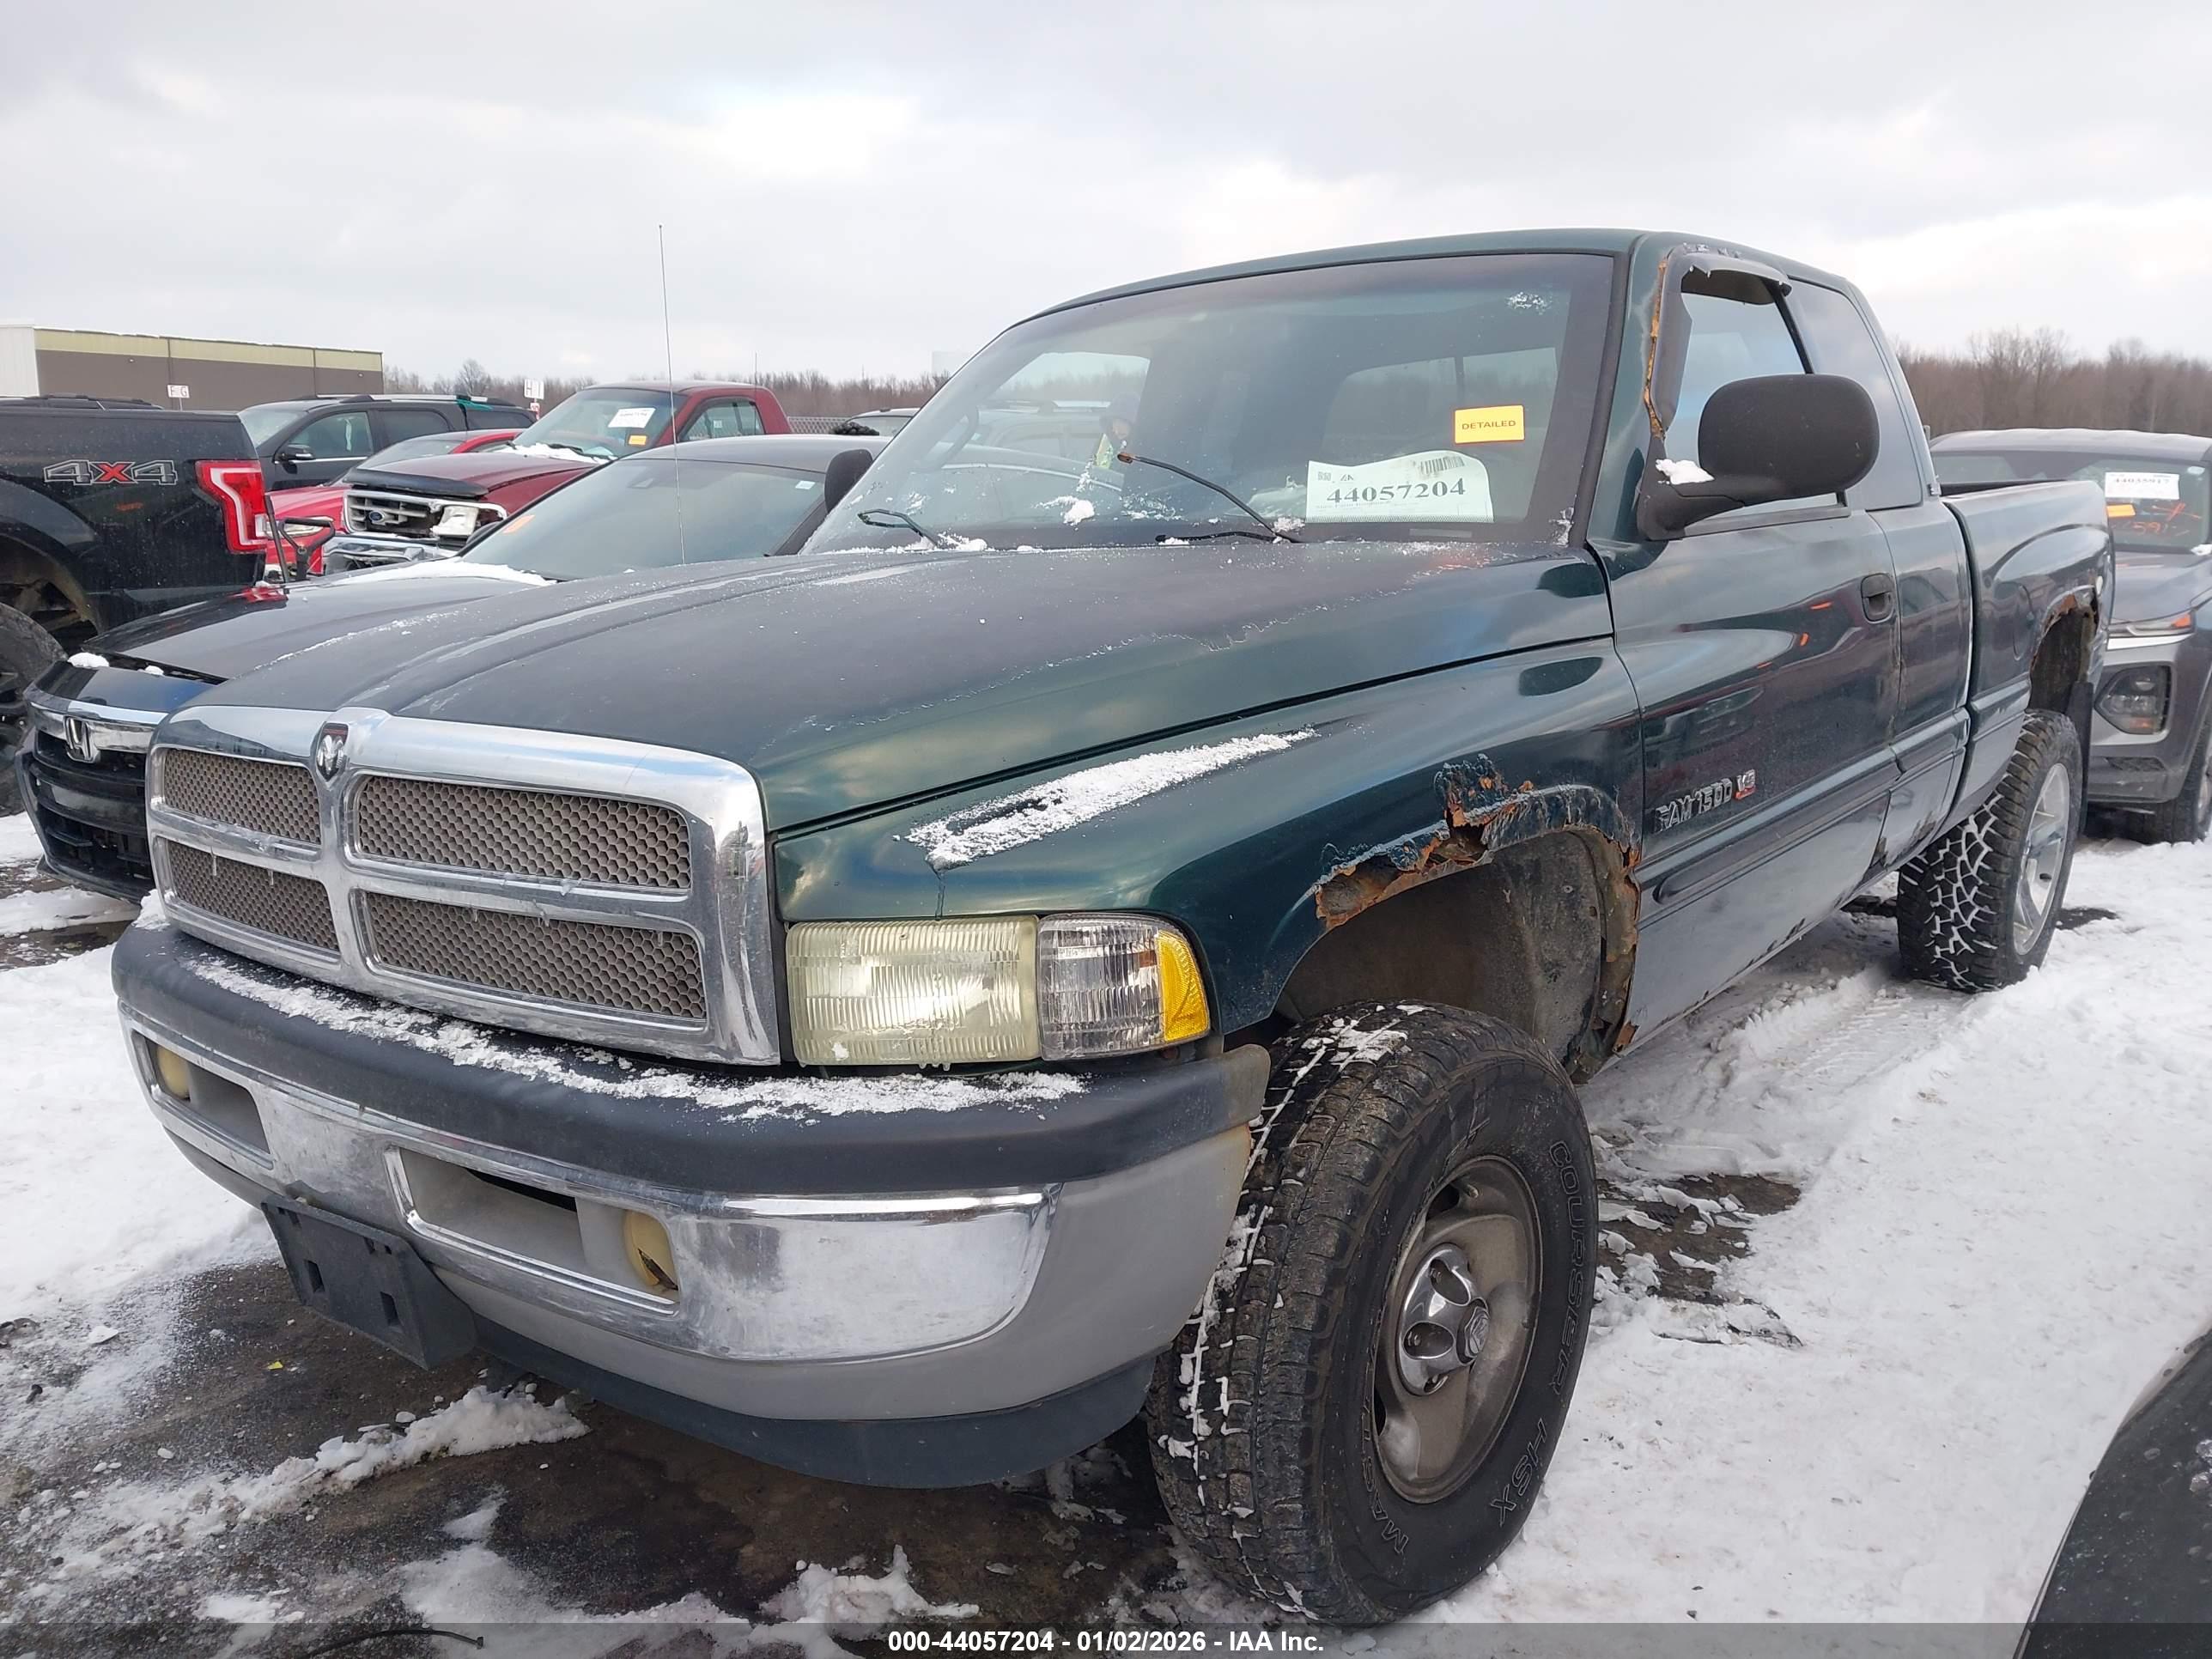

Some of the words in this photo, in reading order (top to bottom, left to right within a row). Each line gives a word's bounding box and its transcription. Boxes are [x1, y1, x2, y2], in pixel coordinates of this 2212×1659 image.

[1462, 420, 1516, 430] DETAILED
[1327, 477, 1467, 504] 44057204
[1654, 794, 1692, 833] RAM
[1694, 777, 1733, 815] 1500
[1549, 1139, 1595, 1395] COURSER
[1490, 1417, 1548, 1528] HSX
